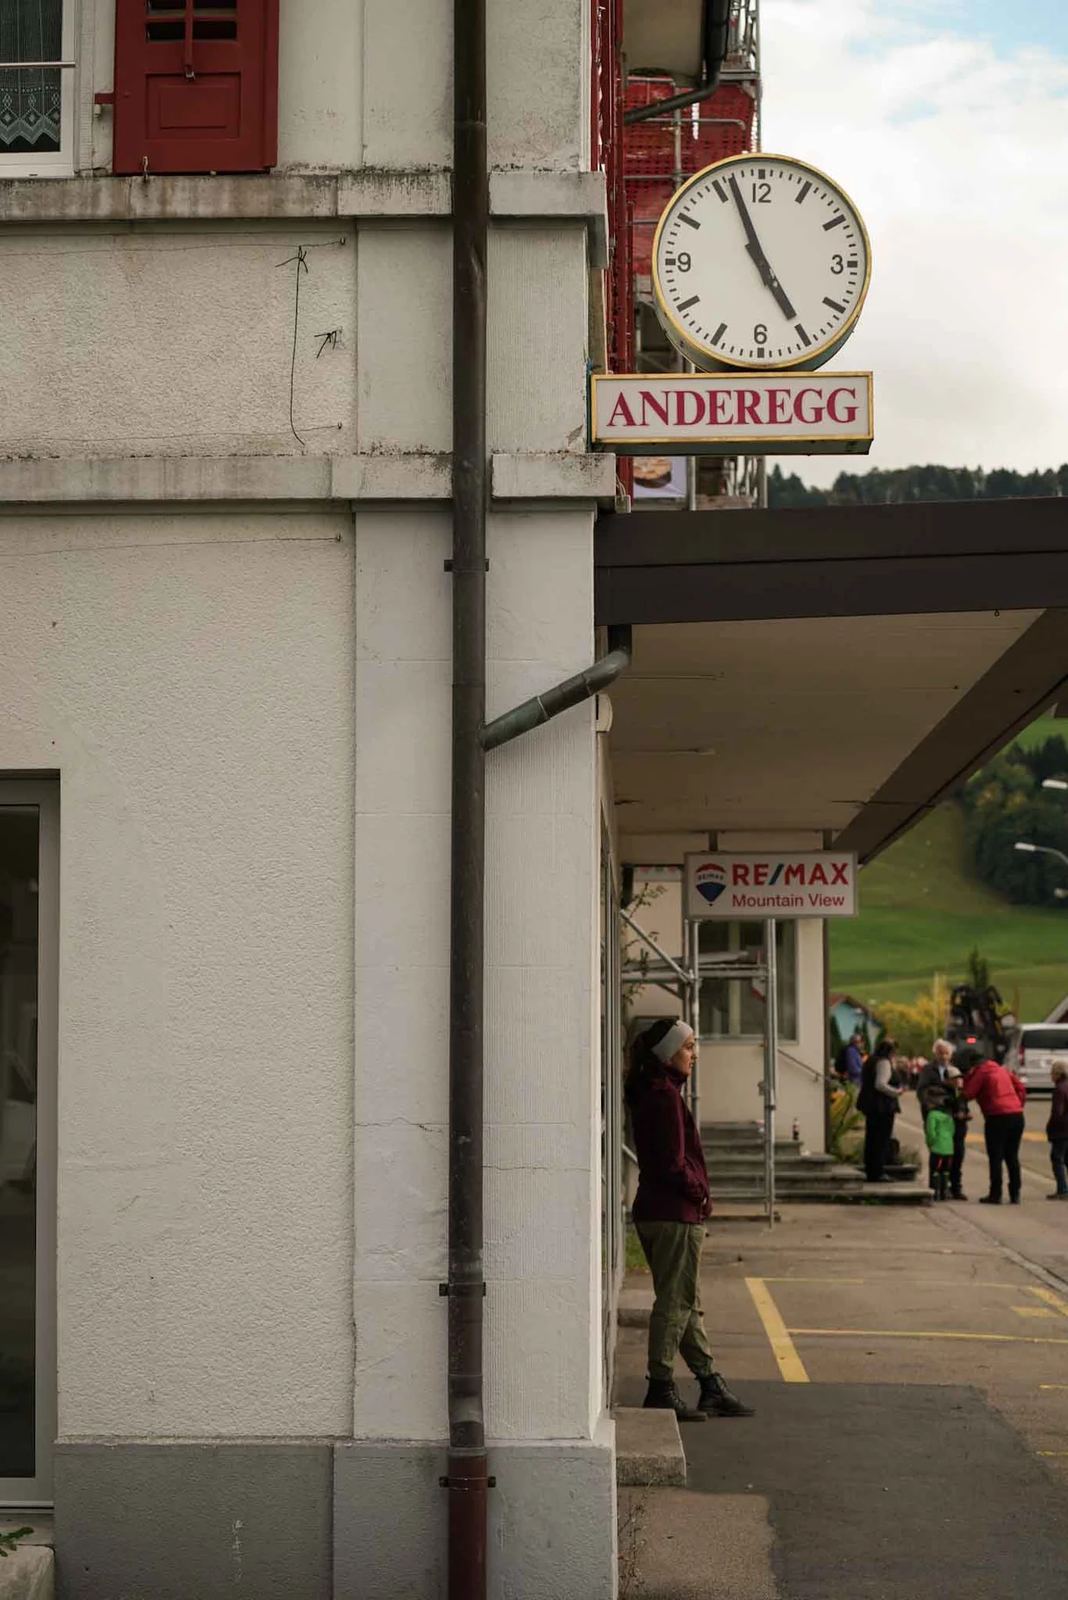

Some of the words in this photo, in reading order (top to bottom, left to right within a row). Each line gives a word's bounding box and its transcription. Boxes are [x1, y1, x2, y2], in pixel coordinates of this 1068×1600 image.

[751, 183, 772, 203] 12
[677, 252, 692, 273] 9
[830, 254, 844, 275] 3
[754, 325, 768, 344] 6
[606, 388, 858, 427] ANDEREGG
[732, 862, 849, 886] RE/MAX
[732, 894, 804, 908] Mountain
[808, 893, 845, 907] View
